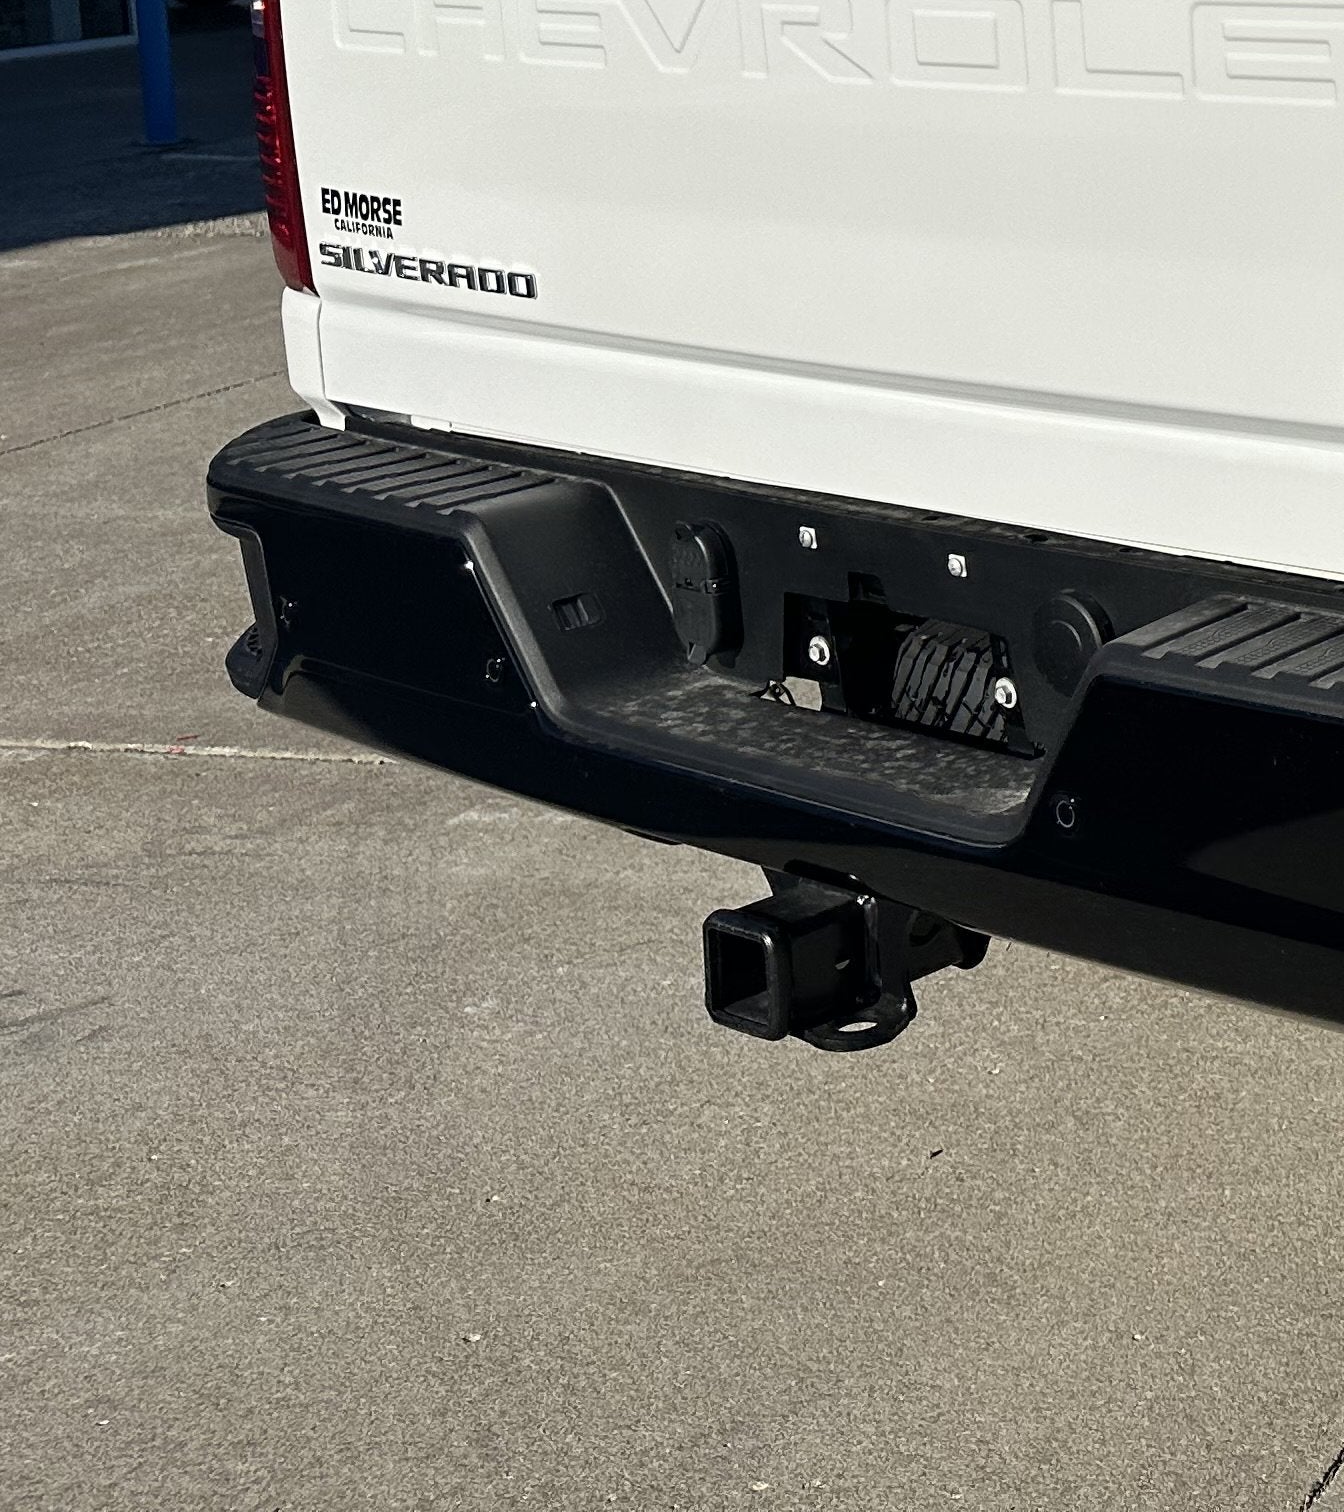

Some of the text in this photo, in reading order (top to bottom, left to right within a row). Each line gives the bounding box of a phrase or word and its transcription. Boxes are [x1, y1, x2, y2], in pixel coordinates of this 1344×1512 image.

[321, 187, 402, 226] ED MORSE
[334, 218, 394, 240] CALIFORNIA
[319, 241, 538, 300] SILVERADO
